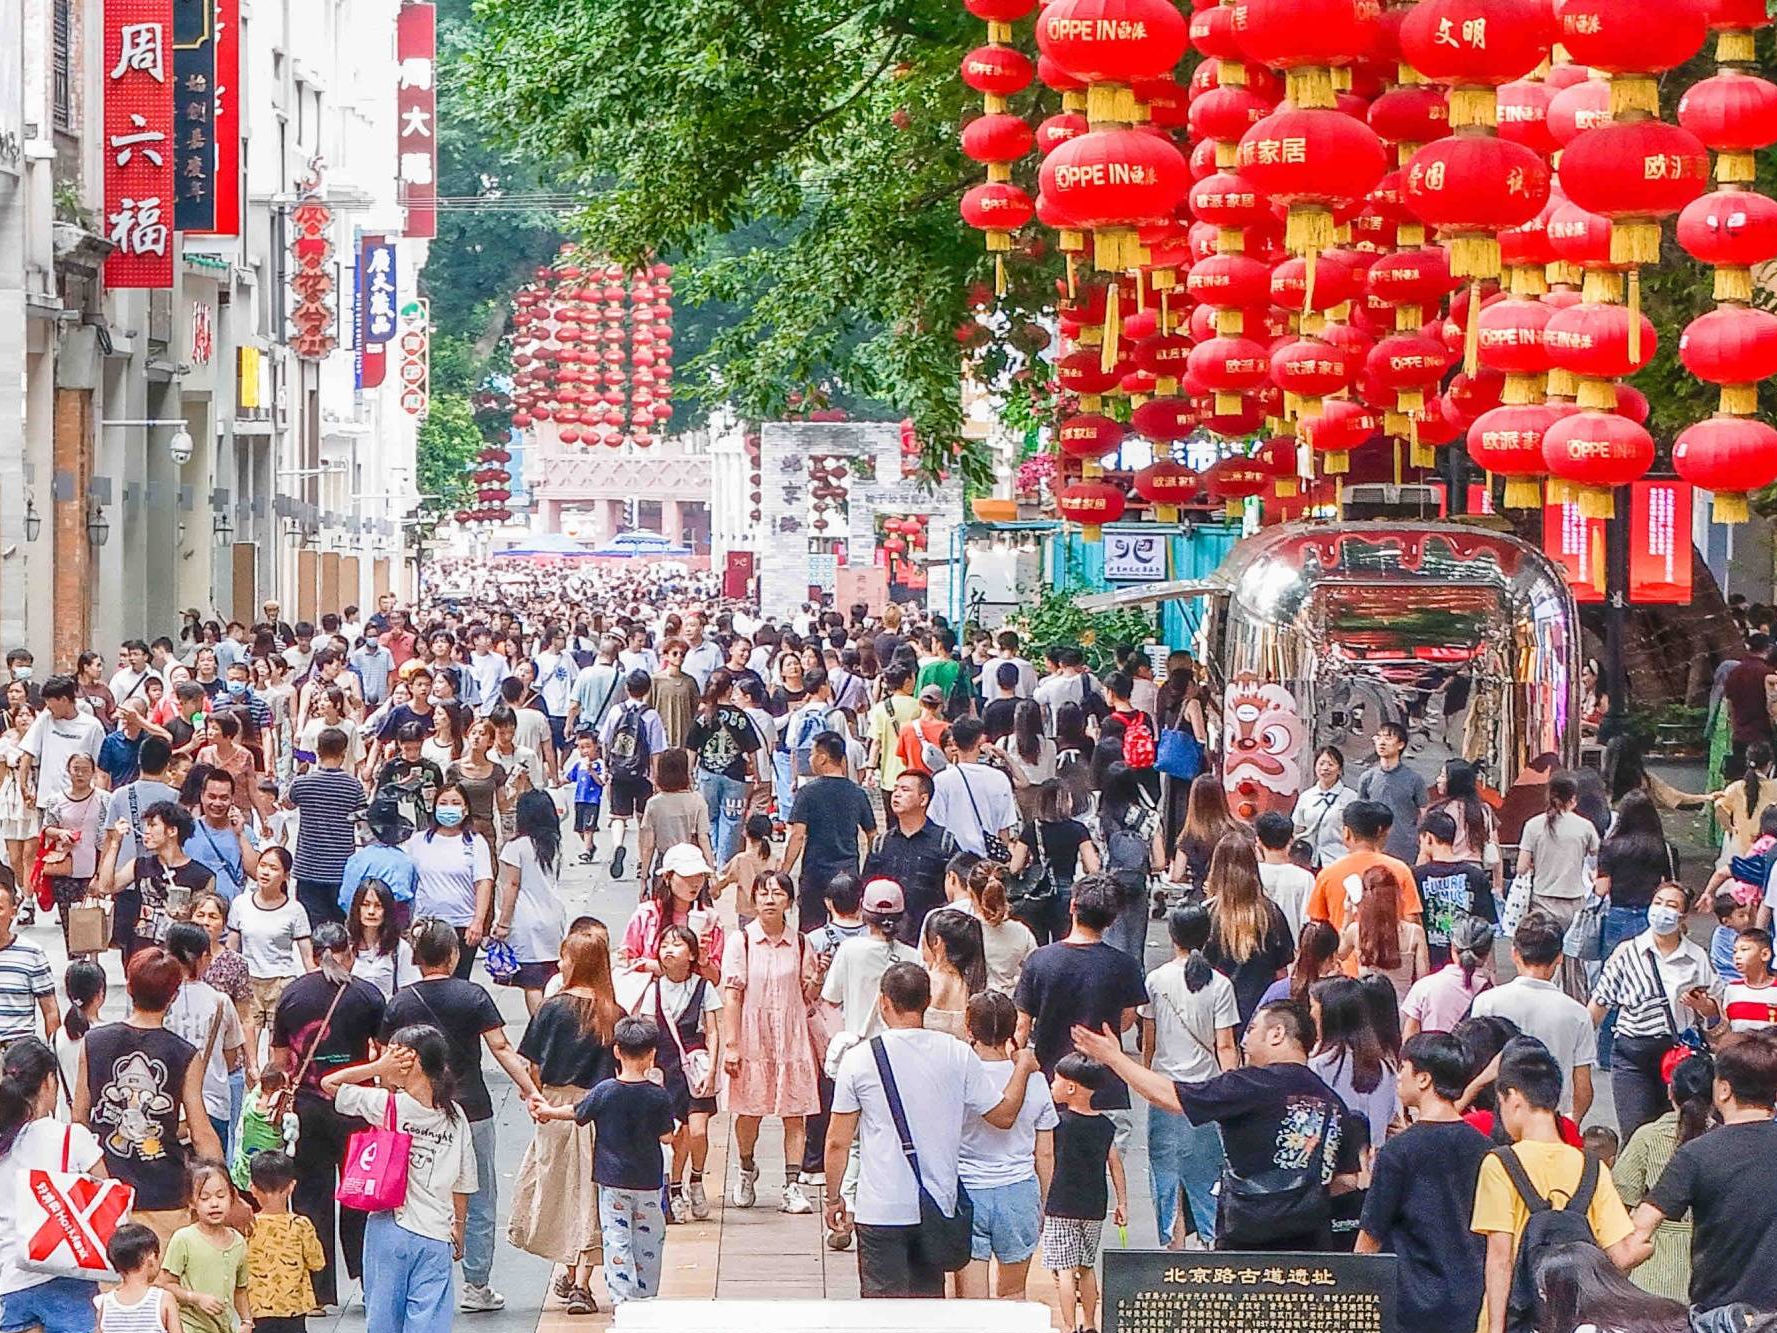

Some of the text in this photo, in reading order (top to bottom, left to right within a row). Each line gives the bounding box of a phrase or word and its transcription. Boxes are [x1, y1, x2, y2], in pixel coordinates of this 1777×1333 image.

[1434, 17, 1487, 50] 文明
[110, 22, 167, 257] 周六福
[402, 1122, 454, 1144] Goodnight
[1164, 1266, 1336, 1286] 北京路古道遗址
